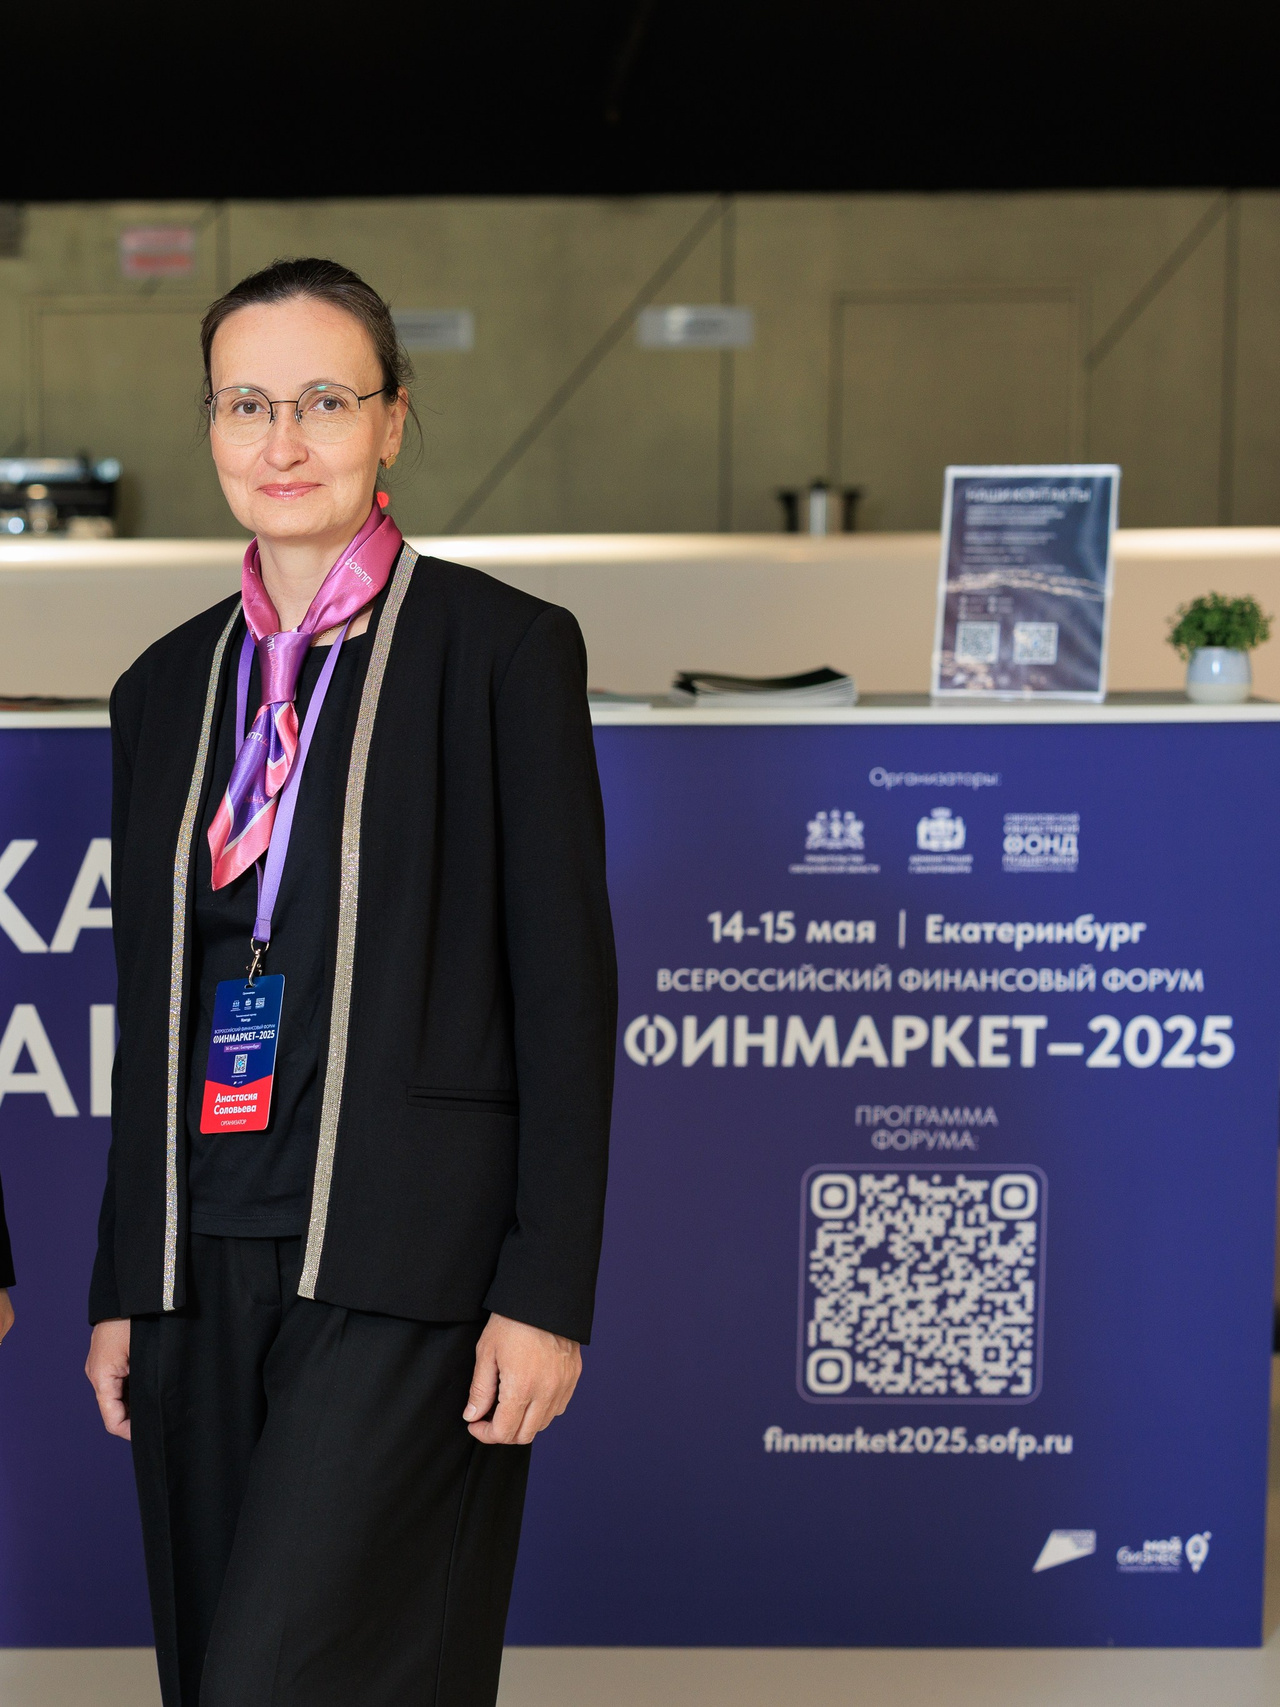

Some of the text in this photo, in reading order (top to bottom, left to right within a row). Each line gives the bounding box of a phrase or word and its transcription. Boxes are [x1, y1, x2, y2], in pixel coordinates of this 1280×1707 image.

[1002, 832, 1078, 856] ФОНД
[707, 910, 1147, 952] 14-15 мая Екатеринбург
[656, 963, 1205, 993] ВСЕРОССИЙСКИЙ ФИНАНСОВЫЙ ФОРУМ
[213, 1104, 257, 1116] Соловьева
[214, 1092, 258, 1104] Анастасия
[220, 1119, 247, 1127] ОРГАНИЗАТОР
[854, 1104, 1000, 1128] ПРОГРАММА
[763, 1426, 1074, 1462] finmarket2025.sofp.ru
